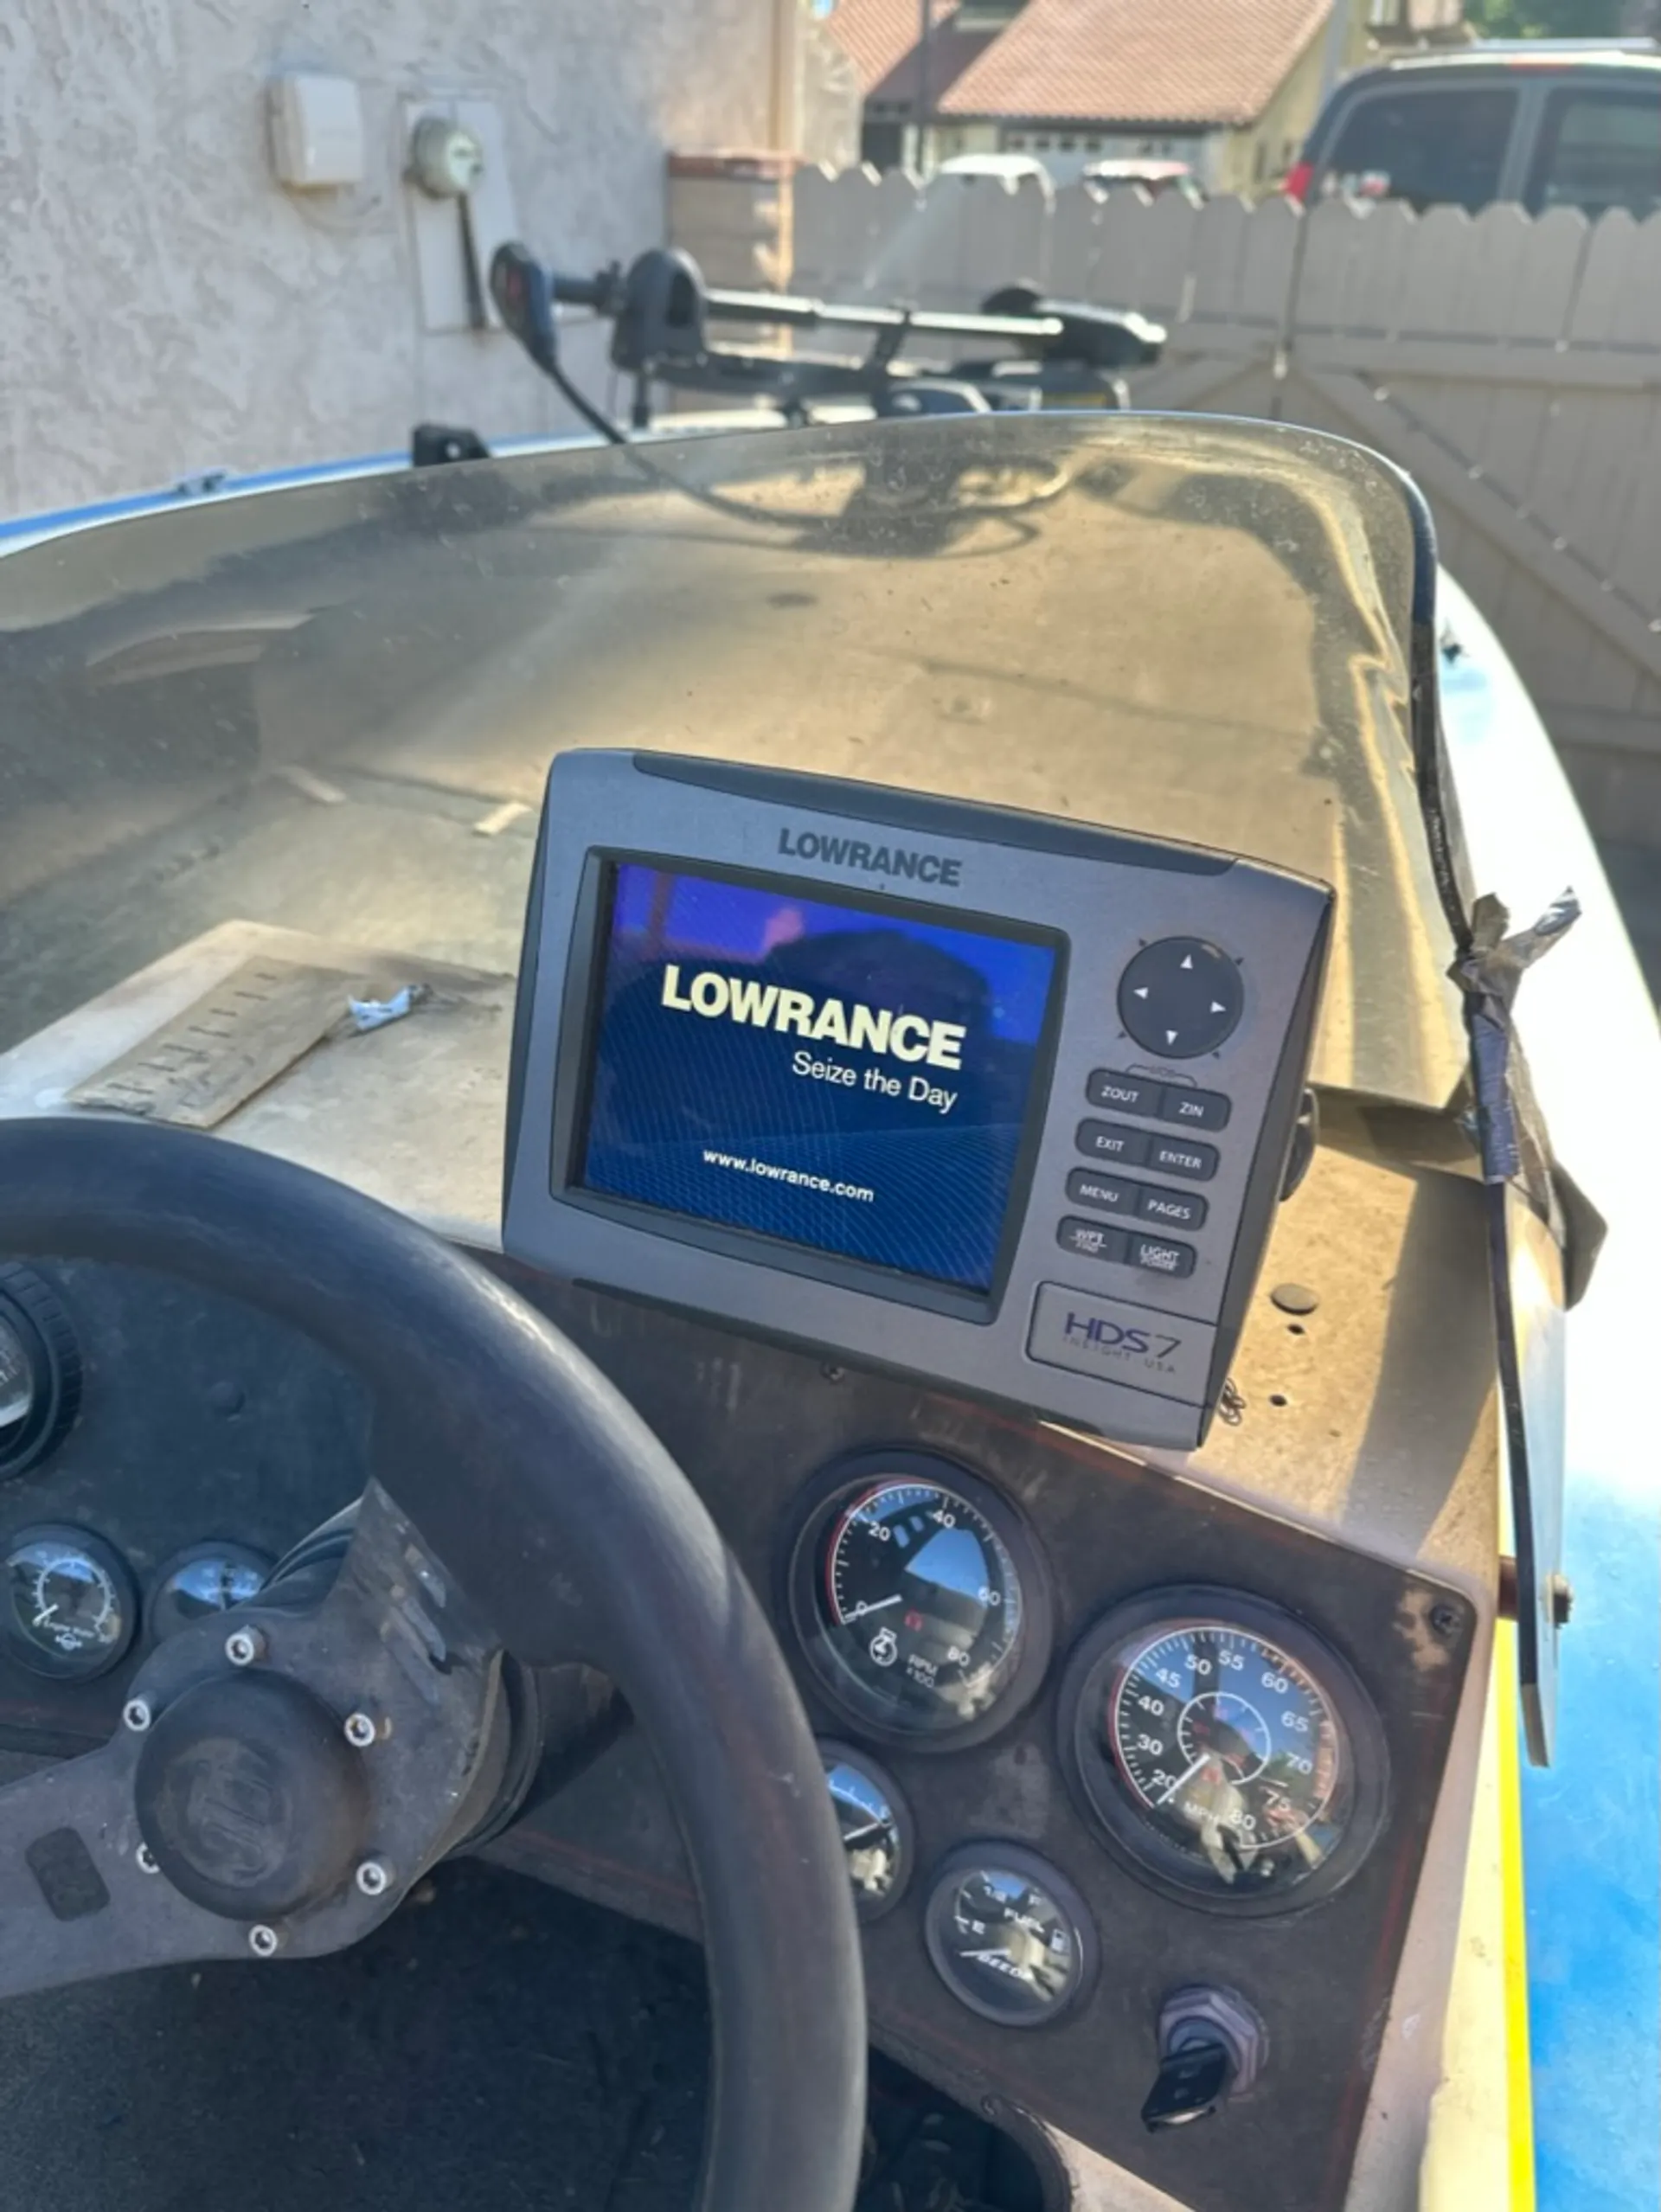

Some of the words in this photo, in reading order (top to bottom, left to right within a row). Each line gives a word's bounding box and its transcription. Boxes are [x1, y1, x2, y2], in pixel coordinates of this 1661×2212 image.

[778, 828, 962, 888] LOWRANCE
[661, 964, 967, 1071] LOWRANCE
[792, 1049, 857, 1088] Seize
[863, 1066, 902, 1098] the
[907, 1075, 958, 1115] Day
[1100, 1085, 1140, 1103] ZOUT
[1178, 1101, 1205, 1118] ZIN
[1094, 1135, 1126, 1152] EXIT
[1158, 1150, 1202, 1170] ENTER
[702, 1149, 875, 1203] www.lowrance.com
[1079, 1183, 1120, 1203] MENU
[1146, 1198, 1192, 1221] PAGES
[932, 1509, 957, 1529] 40
[869, 1521, 891, 1542] 20
[1183, 1653, 1212, 1676] 50
[1217, 1649, 1245, 1671] 55
[1154, 1666, 1182, 1689] 45
[1260, 1670, 1289, 1695] 60
[1138, 1693, 1166, 1716] 40
[1280, 1709, 1310, 1733] 65
[1137, 1733, 1164, 1756] 30
[1286, 1752, 1314, 1775] 70
[1151, 1768, 1178, 1790] 20
[1230, 1808, 1258, 1831] 80
